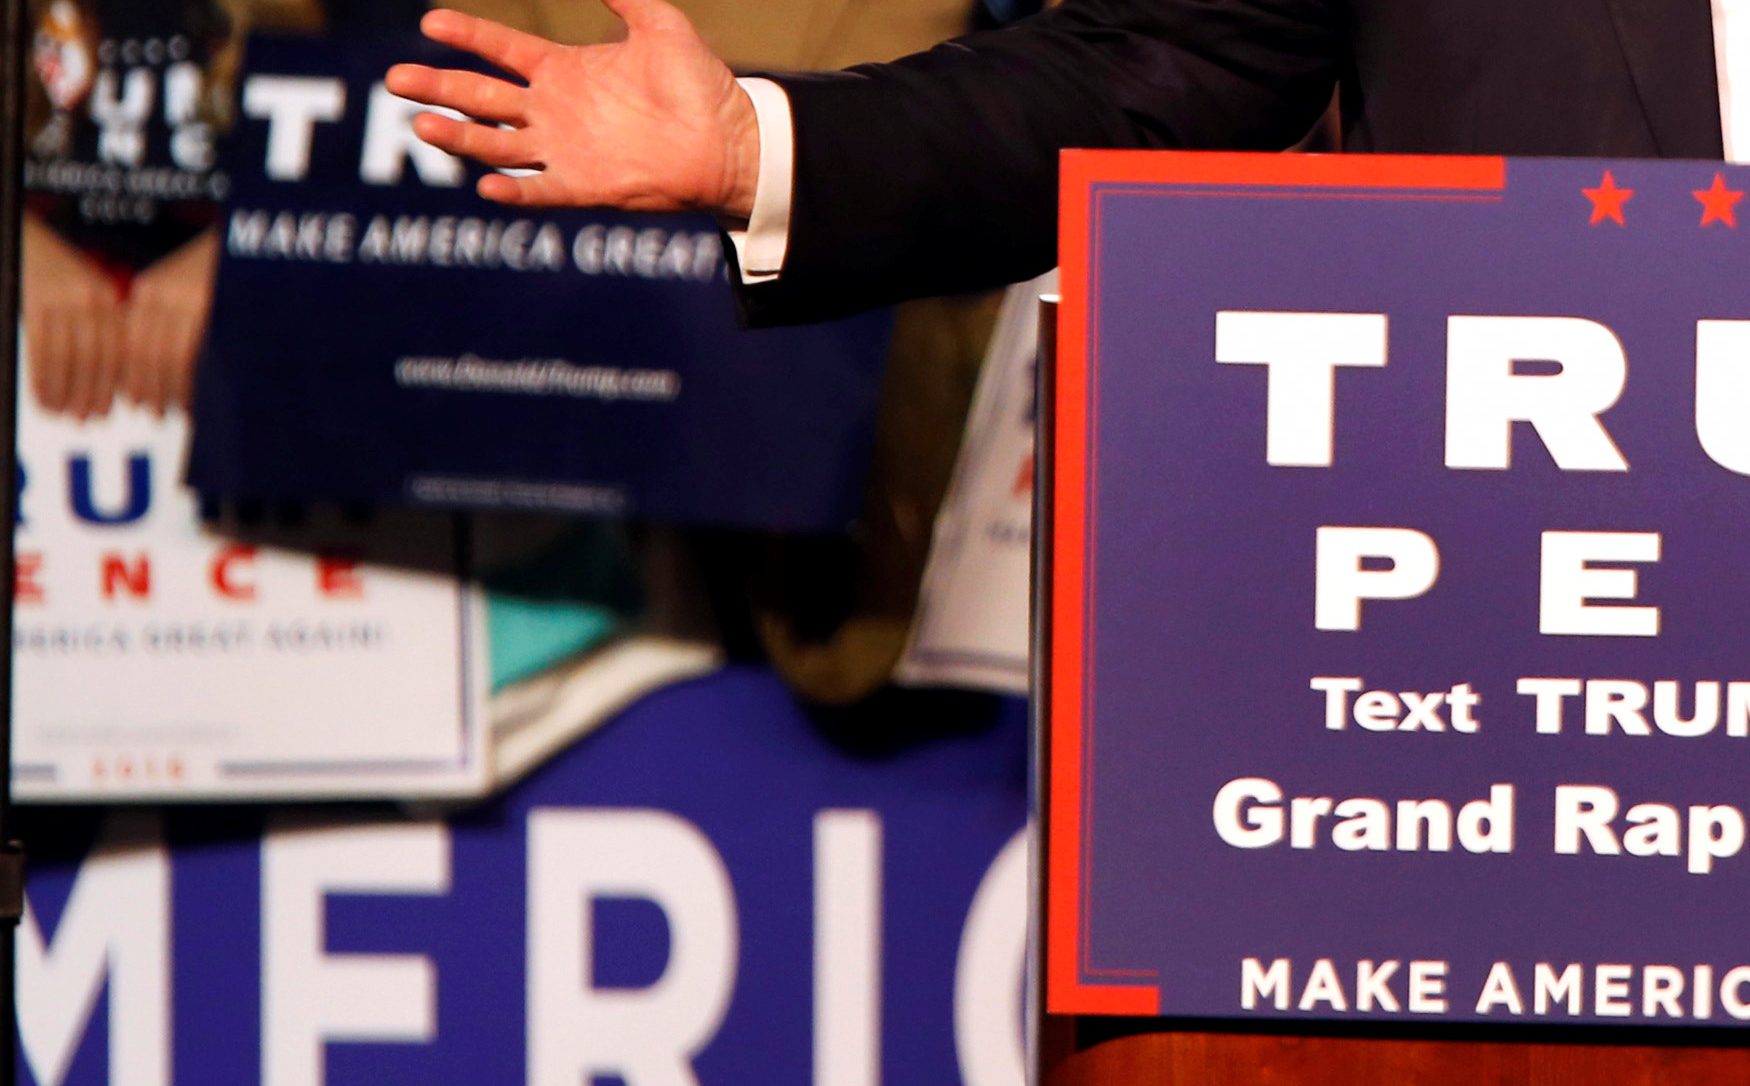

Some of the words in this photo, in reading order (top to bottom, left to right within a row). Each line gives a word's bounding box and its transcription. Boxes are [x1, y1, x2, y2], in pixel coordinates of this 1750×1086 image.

[228, 211, 358, 262] MAKE
[359, 214, 566, 272] AMERICA
[572, 224, 722, 282] GREAT
[1309, 676, 1479, 734] Text
[1212, 777, 1514, 854] Grand
[1240, 957, 1446, 1014] MAKE
